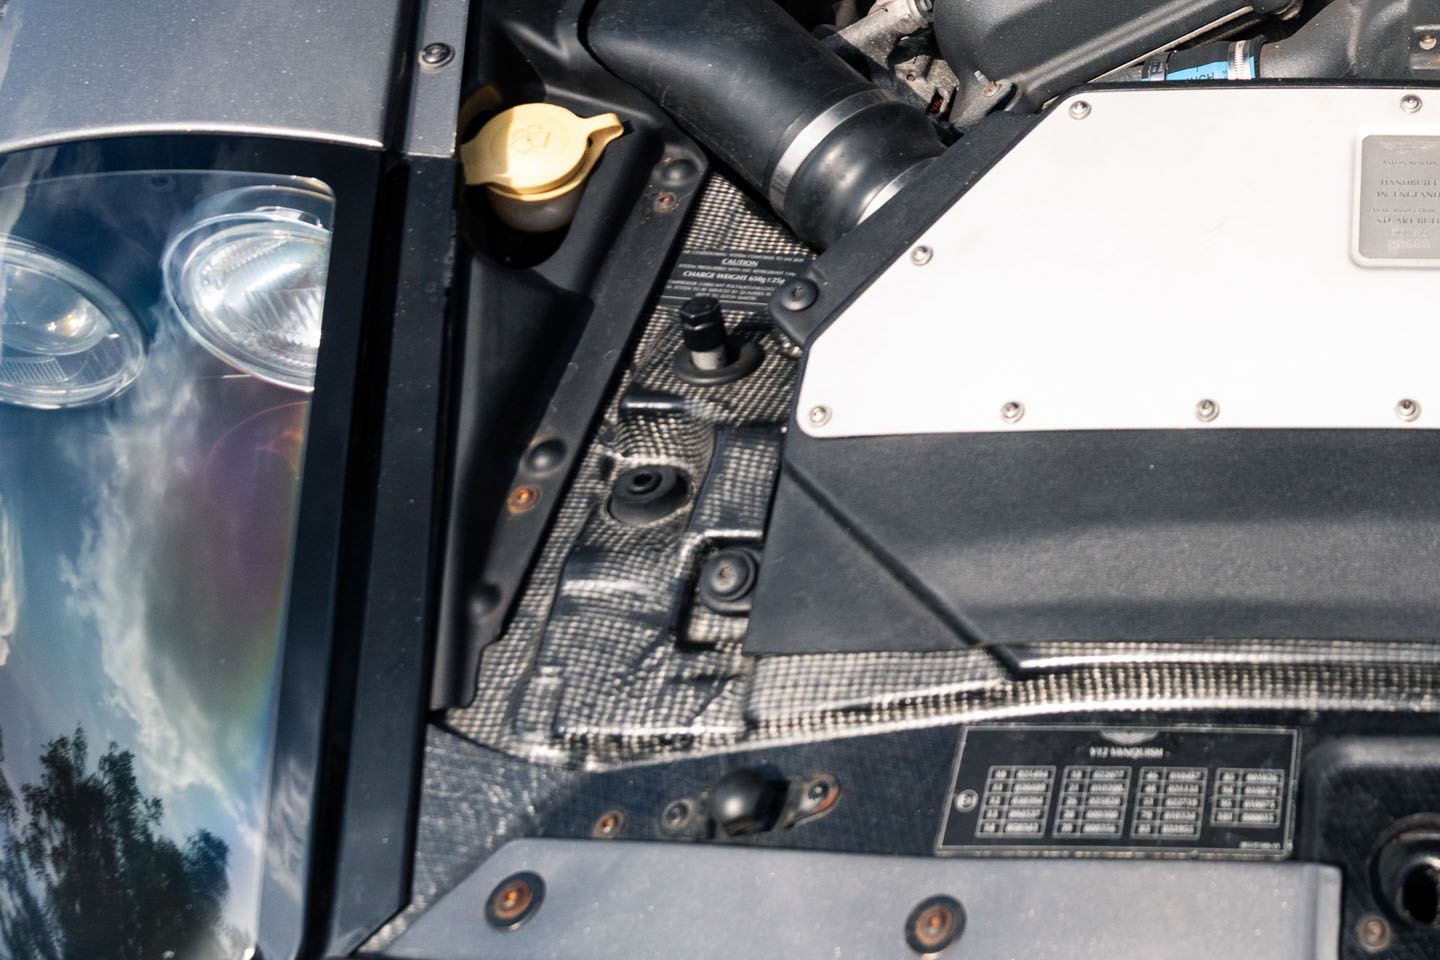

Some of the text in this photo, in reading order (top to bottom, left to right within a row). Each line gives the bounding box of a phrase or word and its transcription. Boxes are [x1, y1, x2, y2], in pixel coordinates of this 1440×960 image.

[1376, 190, 1440, 198] IN ENGLAND
[721, 258, 758, 267] CAUTION
[682, 270, 715, 278] CHARGE
[715, 273, 749, 281] WEIGHT
[1109, 746, 1164, 759] VANQUISH
